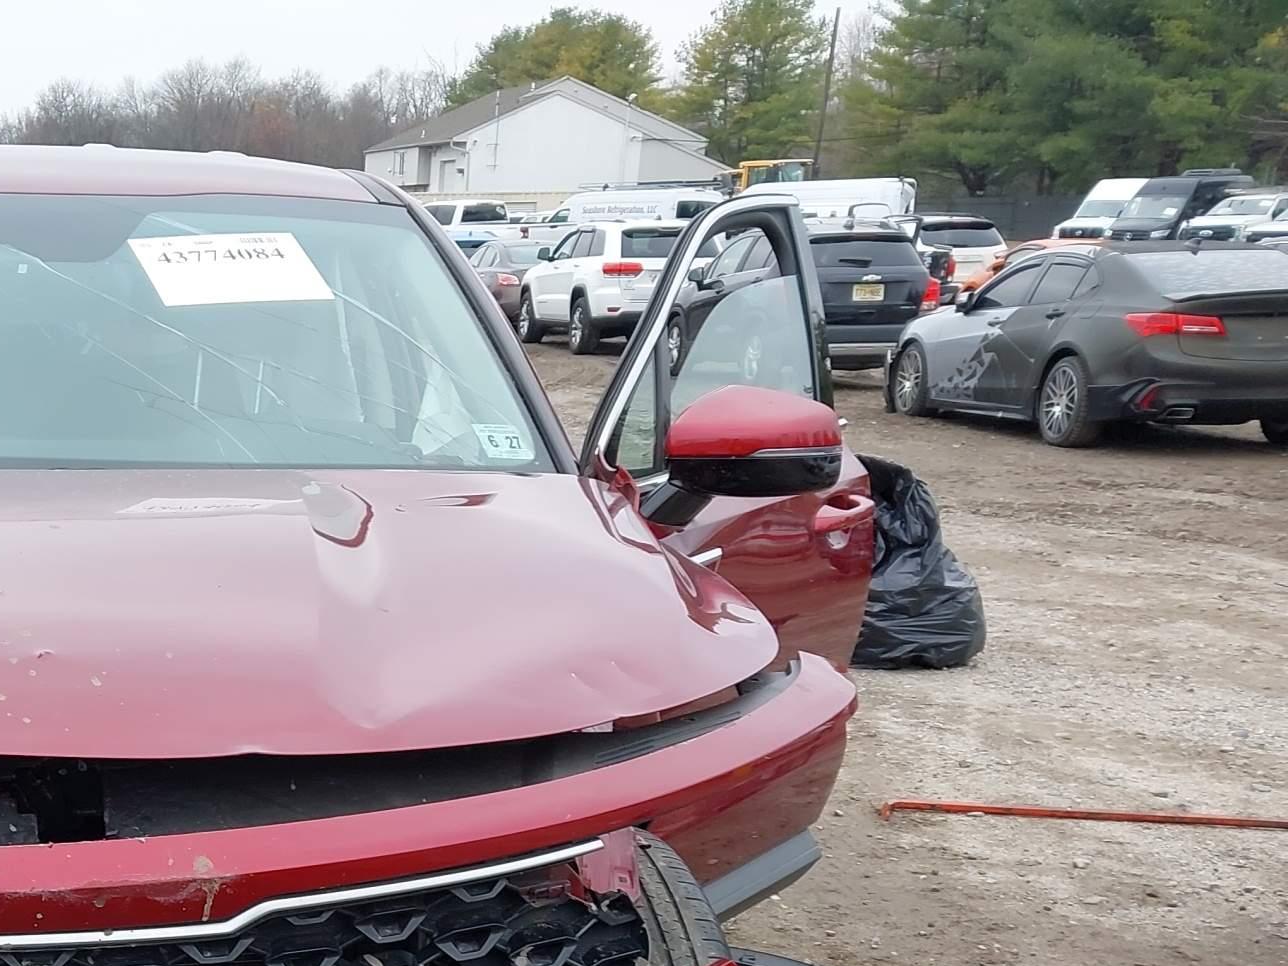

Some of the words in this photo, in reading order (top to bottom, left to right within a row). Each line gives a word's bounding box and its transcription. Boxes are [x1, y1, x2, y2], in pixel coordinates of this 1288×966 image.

[157, 247, 286, 264] 43774084
[487, 434, 500, 450] 6
[505, 436, 522, 450] 27
